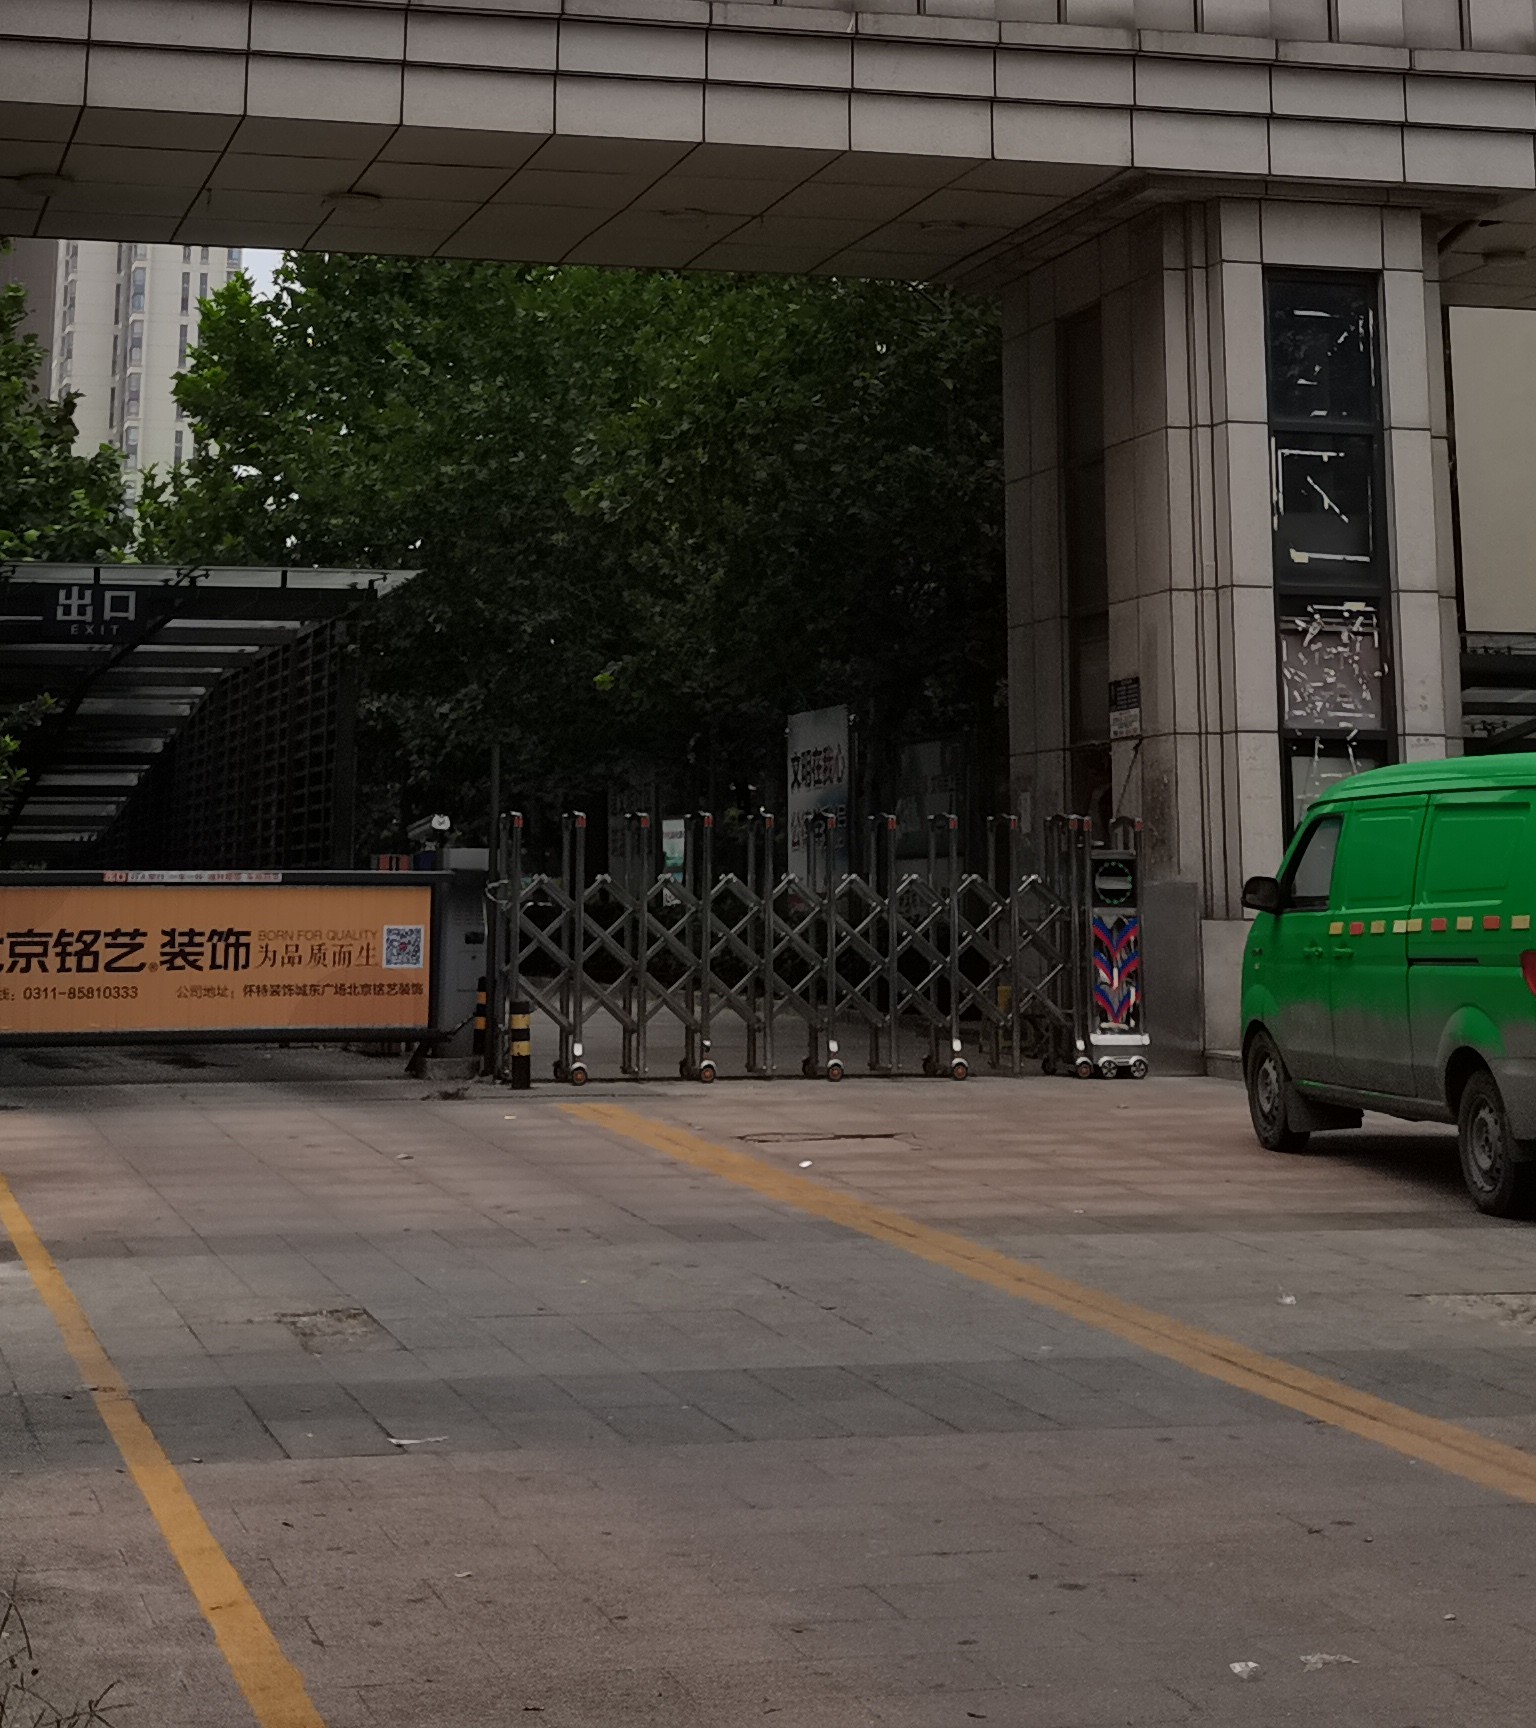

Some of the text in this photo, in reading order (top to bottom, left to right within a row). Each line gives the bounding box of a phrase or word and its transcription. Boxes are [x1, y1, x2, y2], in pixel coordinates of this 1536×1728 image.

[56, 585, 137, 623] 出口
[70, 623, 120, 636] EXIT
[258, 928, 378, 942] BORN FOR QUALITY
[254, 941, 380, 970] 为品质而生
[22, 985, 139, 1001] 0311-85810333
